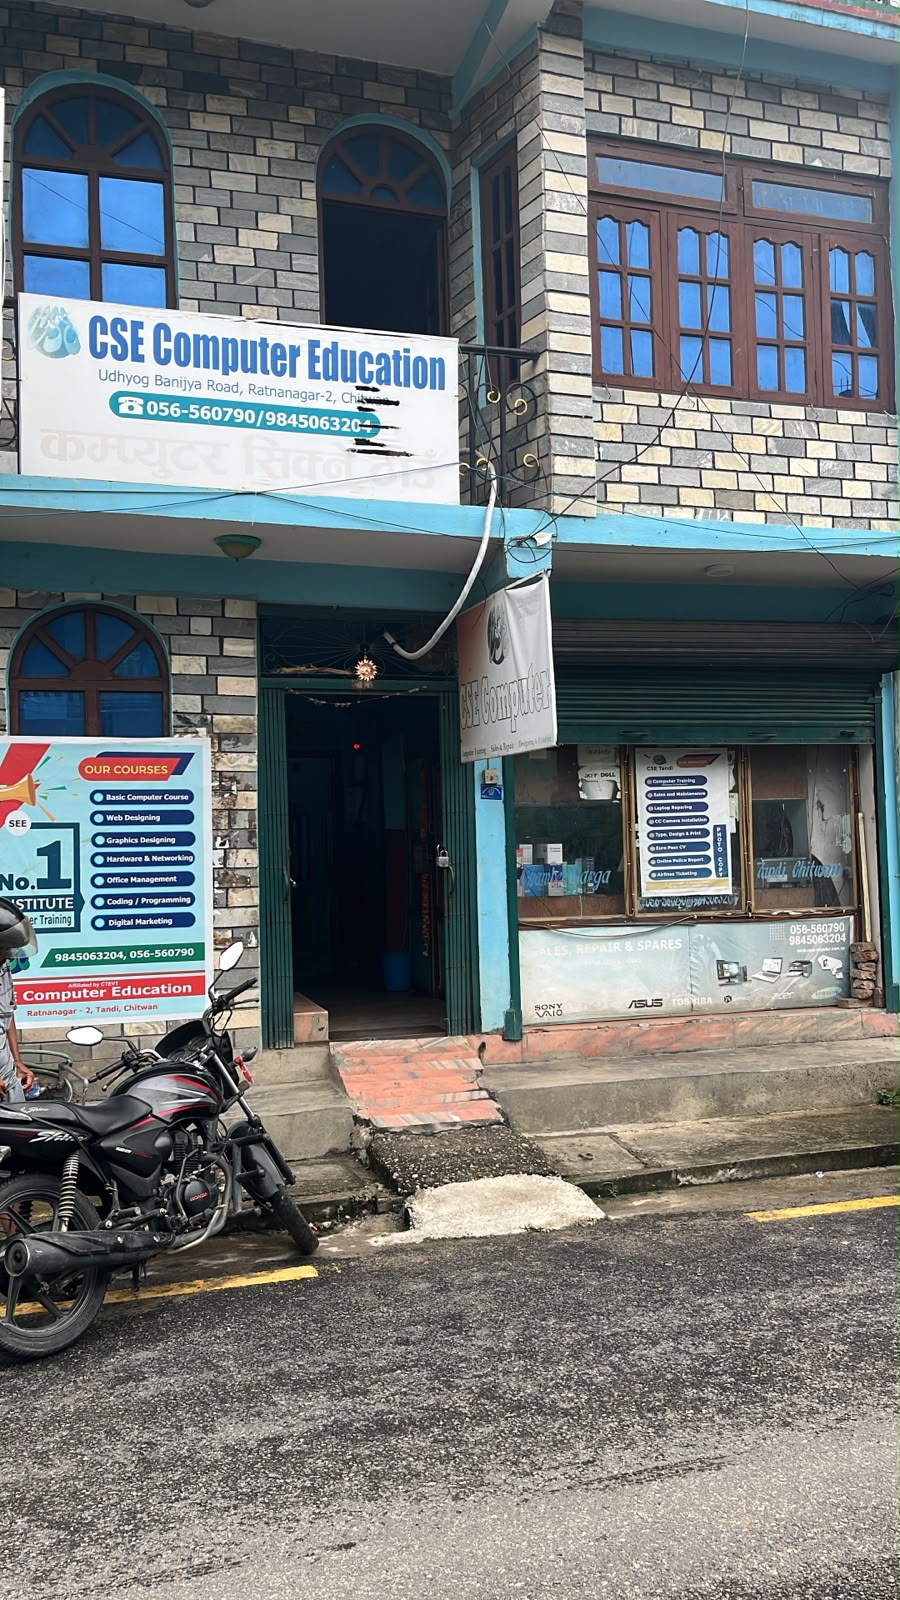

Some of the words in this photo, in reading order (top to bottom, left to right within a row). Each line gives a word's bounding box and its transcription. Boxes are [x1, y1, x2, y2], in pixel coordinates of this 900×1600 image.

[89, 315, 145, 363] CSE
[153, 322, 301, 378] Computer
[308, 339, 446, 391] Education
[98, 369, 149, 388] Udhyog
[155, 375, 202, 392] Banijya
[207, 380, 243, 396] Road,
[248, 384, 337, 405] Ratnanagar-2,
[146, 401, 373, 433] 056-560790/9845063204
[460, 680, 480, 730] CSE
[481, 663, 551, 733] Computer
[84, 765, 111, 774] OUR
[113, 765, 168, 774] COURSES
[127, 794, 162, 802] Computer
[8, 820, 27, 828] SEE
[124, 814, 160, 822] Designing
[106, 837, 139, 845] Graphics
[140, 836, 176, 845] Designing
[151, 855, 193, 863] Networking
[757, 861, 787, 879] Tandi
[792, 860, 842, 878] Chitwan
[130, 876, 177, 884] Management
[12, 897, 74, 910] STITUTE
[107, 898, 133, 906] Coding
[135, 898, 139, 906] /
[141, 896, 191, 905] Programming
[40, 914, 72, 926] Training
[108, 919, 134, 927] Digital
[135, 917, 173, 926] Marketing
[790, 922, 845, 935] 056-560790
[789, 933, 847, 946] 9845063204
[576, 942, 622, 954] REPAIR
[625, 941, 633, 951] &
[637, 939, 683, 951] SPARES
[55, 951, 127, 962] 9845063204,
[129, 948, 195, 959] 056-560790
[22, 988, 107, 1002] Computer
[111, 983, 192, 997] Education
[534, 1003, 563, 1011] SONY
[627, 998, 663, 1009] ASUS
[27, 1008, 77, 1017] Ratnanagar
[95, 1005, 122, 1013] Tandi,
[123, 1003, 158, 1012] Chitwan
[535, 1010, 563, 1018] VAIO
